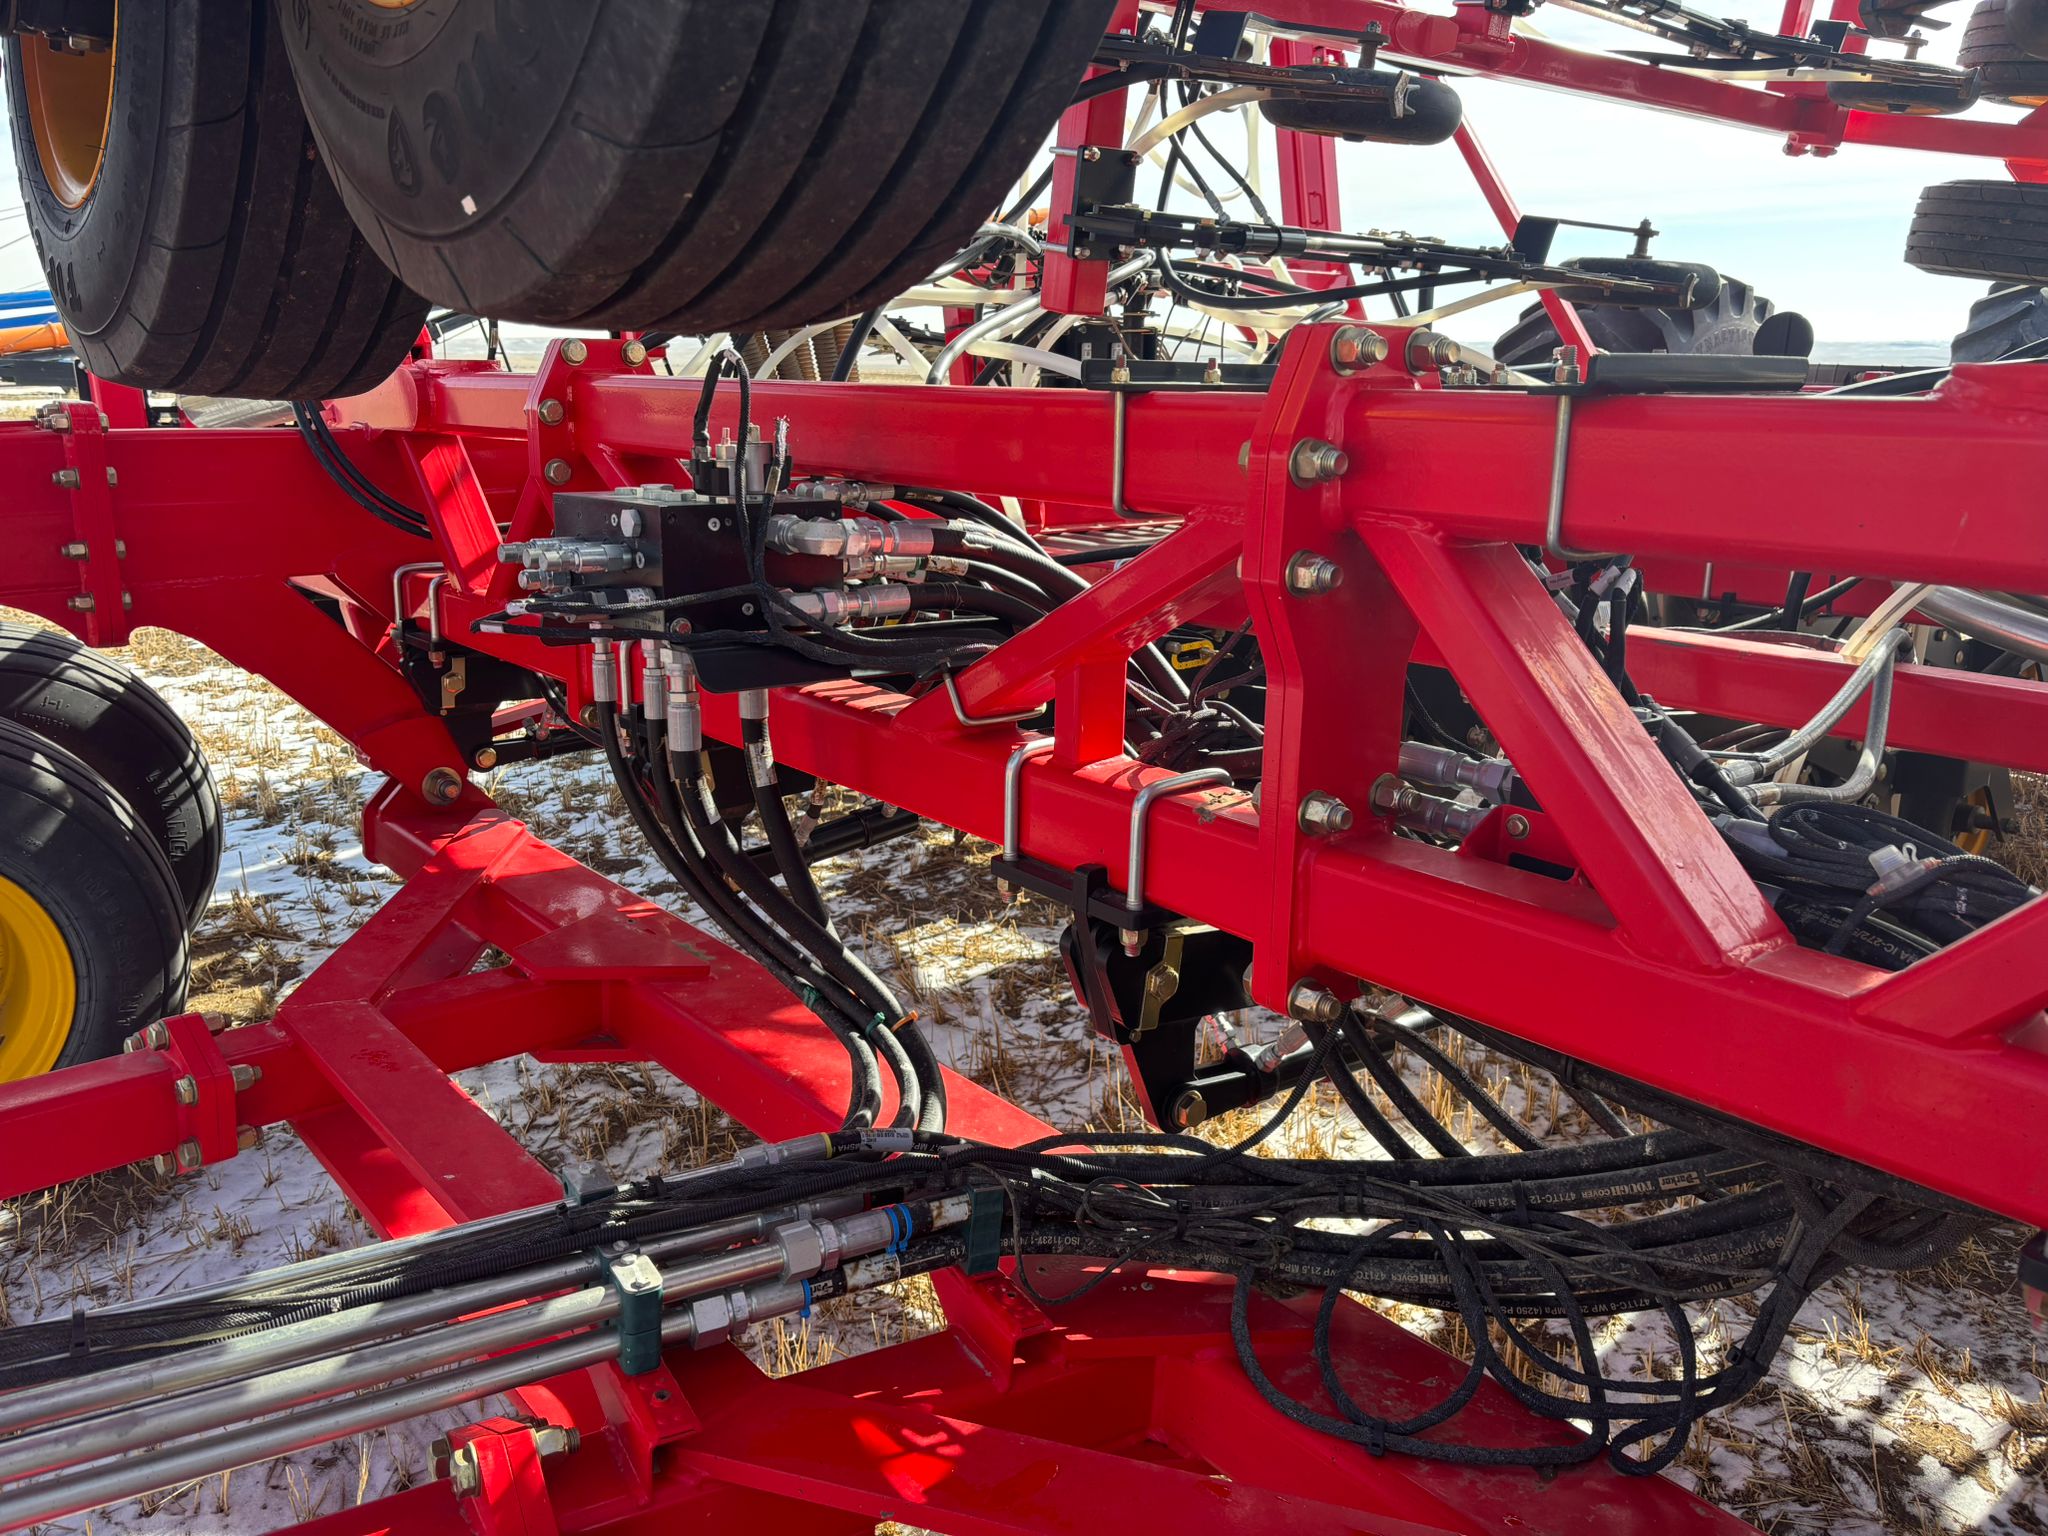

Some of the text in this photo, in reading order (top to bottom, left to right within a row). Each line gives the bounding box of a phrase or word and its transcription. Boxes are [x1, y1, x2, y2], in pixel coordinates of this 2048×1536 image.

[1660, 1172, 1699, 1190] Parker
[1528, 1191, 1577, 1204] 471TC-12
[1065, 1236, 1081, 1246] ISO
[1590, 1303, 1609, 1313] WP
[1610, 1297, 1651, 1311] 471TC-8
